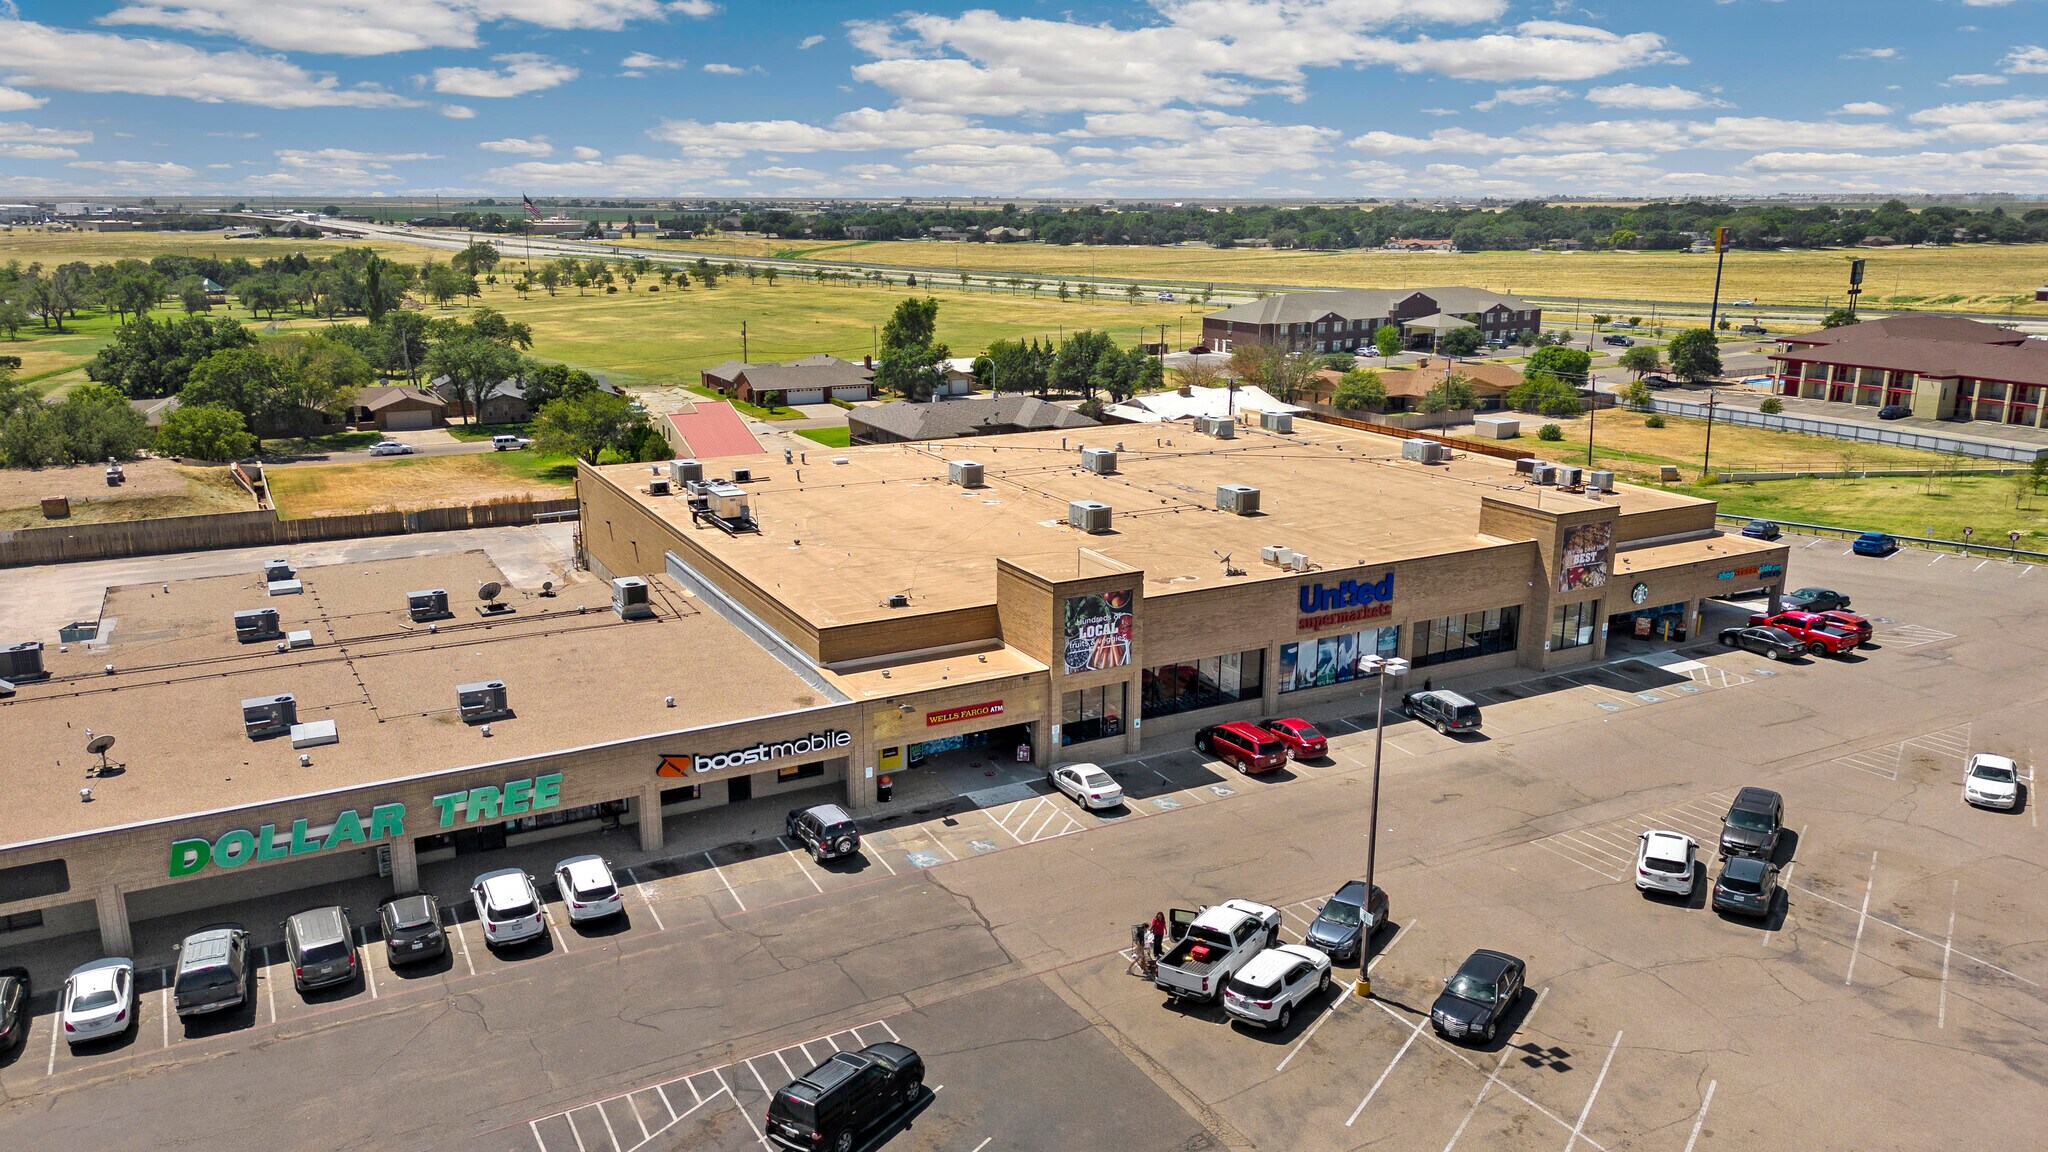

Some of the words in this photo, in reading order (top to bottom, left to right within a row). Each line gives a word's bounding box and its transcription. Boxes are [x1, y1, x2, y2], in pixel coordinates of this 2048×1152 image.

[1574, 552, 1597, 564] BEST
[1299, 572, 1394, 613] United
[1299, 604, 1392, 631] supermarkets
[1079, 622, 1118, 639] LOCAL
[929, 712, 959, 723] WELLS
[961, 707, 989, 718] FARGO
[990, 704, 1004, 713] ATM
[168, 802, 405, 878] DOLLAR
[432, 772, 563, 828] TREE
